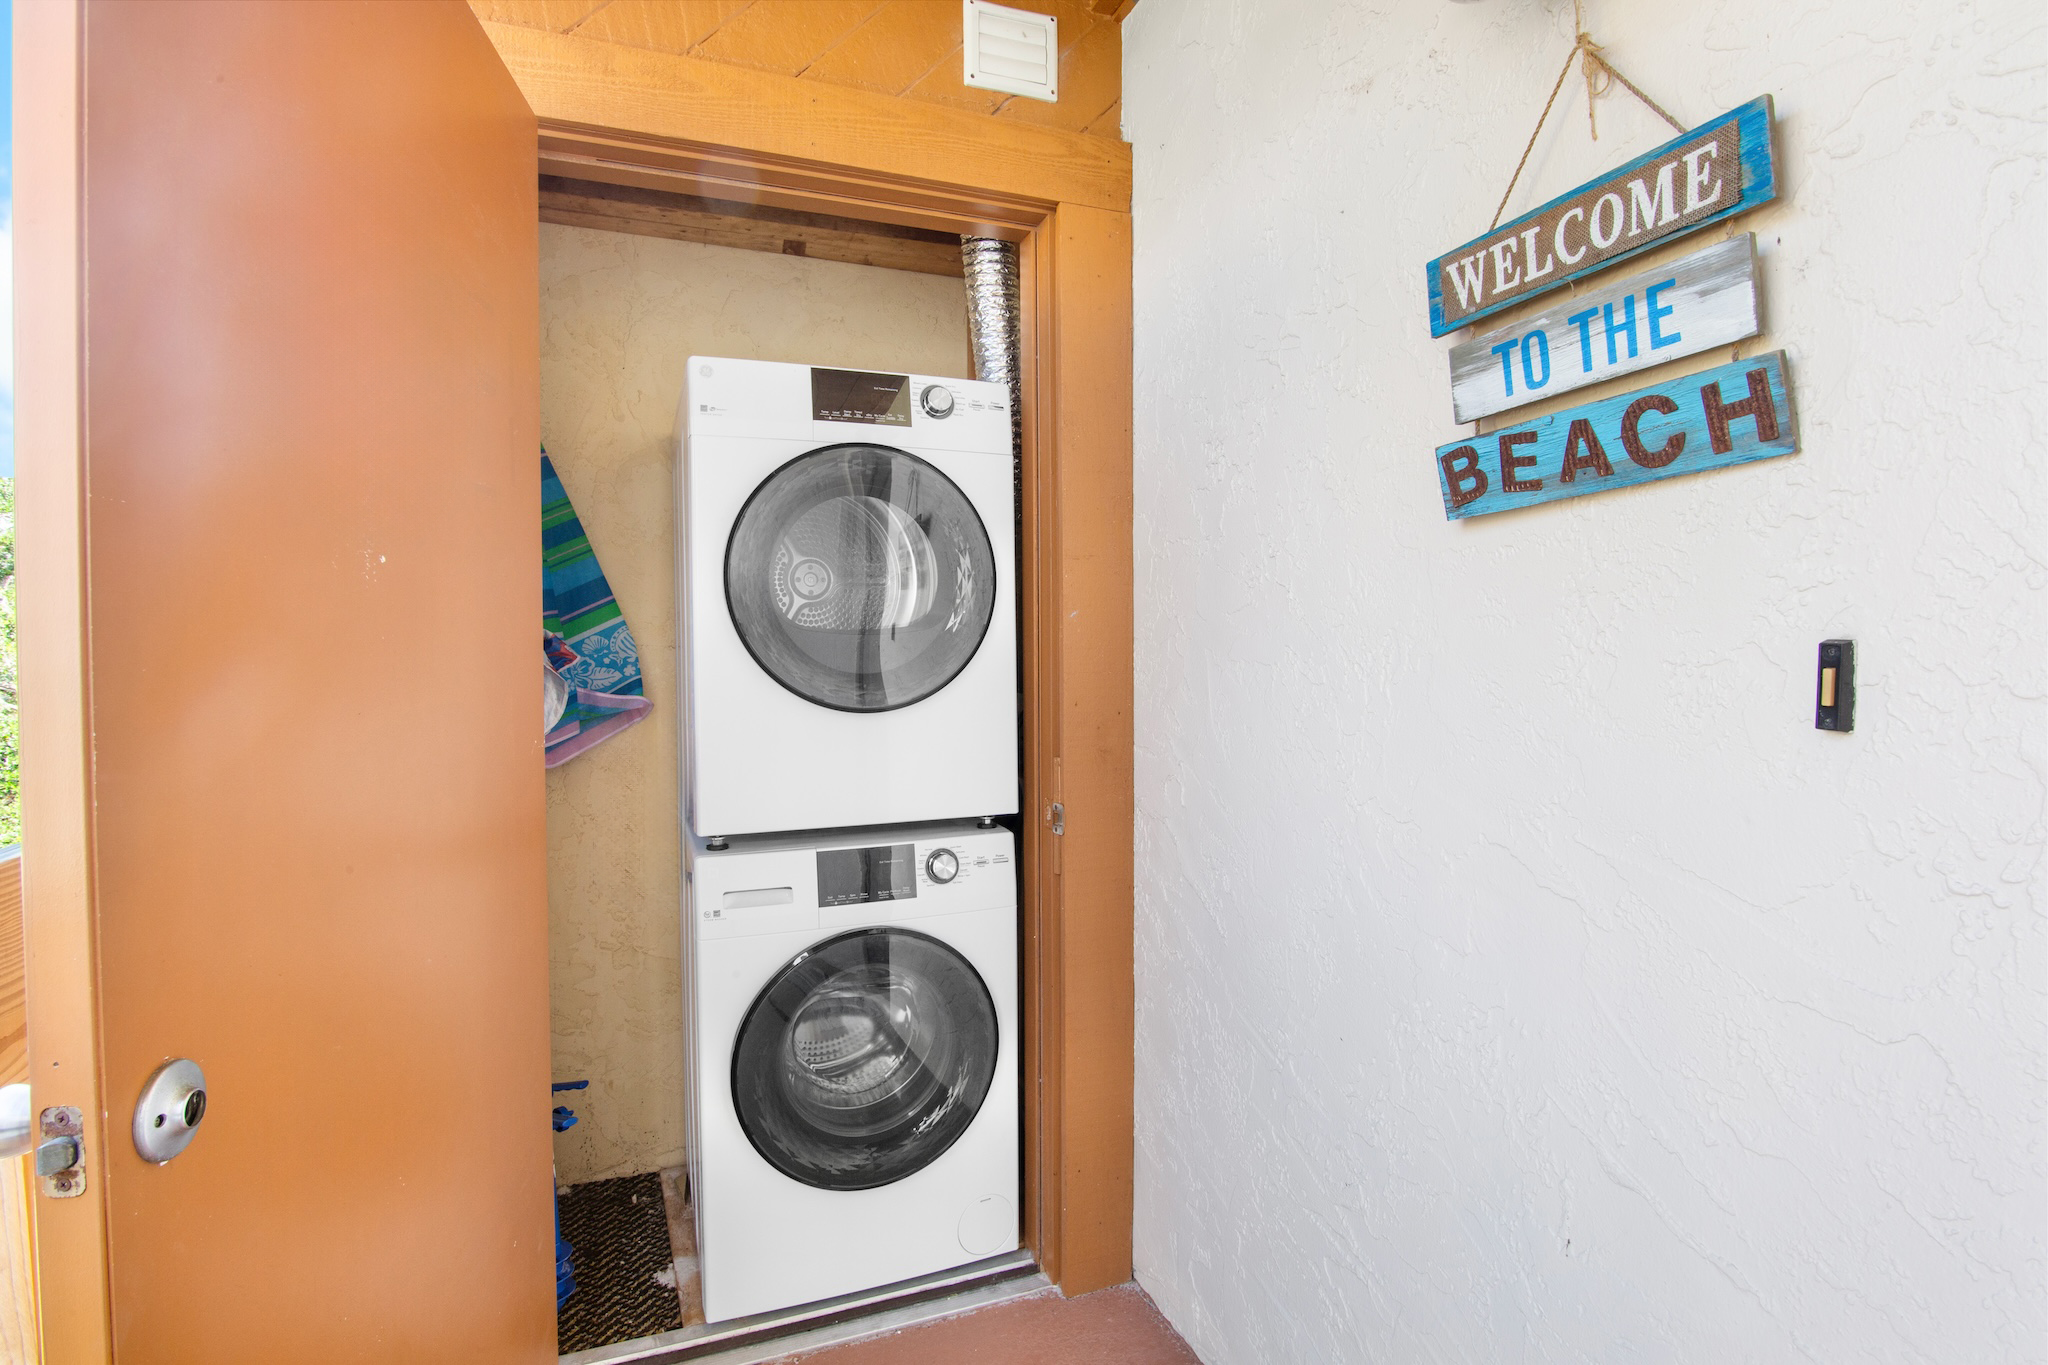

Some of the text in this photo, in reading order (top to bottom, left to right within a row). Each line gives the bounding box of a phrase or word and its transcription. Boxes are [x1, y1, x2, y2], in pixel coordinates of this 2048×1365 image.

[1445, 140, 1722, 310] WELCOME
[1491, 278, 1683, 398] TO THE
[1440, 367, 1780, 509] BEACH
